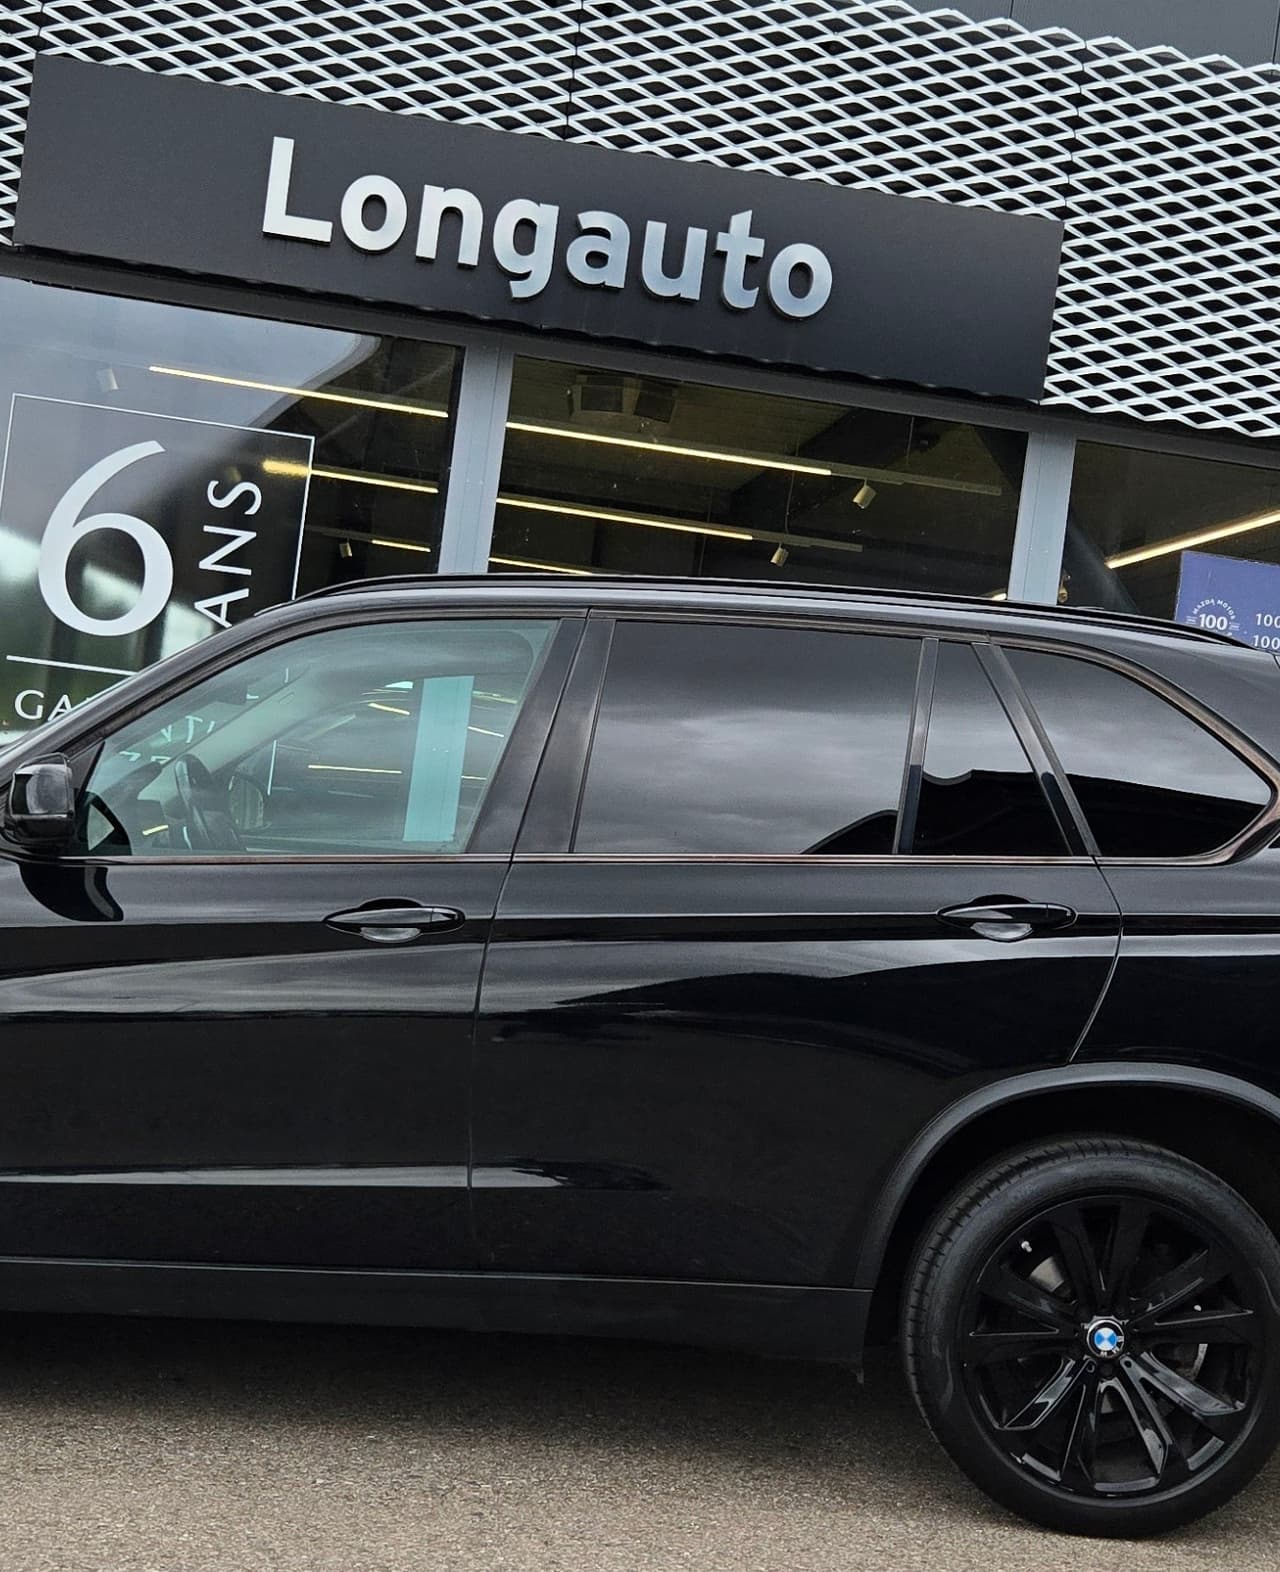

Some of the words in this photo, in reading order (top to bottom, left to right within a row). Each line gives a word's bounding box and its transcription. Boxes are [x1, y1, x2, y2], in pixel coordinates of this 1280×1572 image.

[262, 136, 833, 319] Longauto
[38, 440, 174, 637] 6
[193, 480, 263, 629] ANS
[1199, 613, 1228, 631] 100
[1252, 634, 1280, 650] 100
